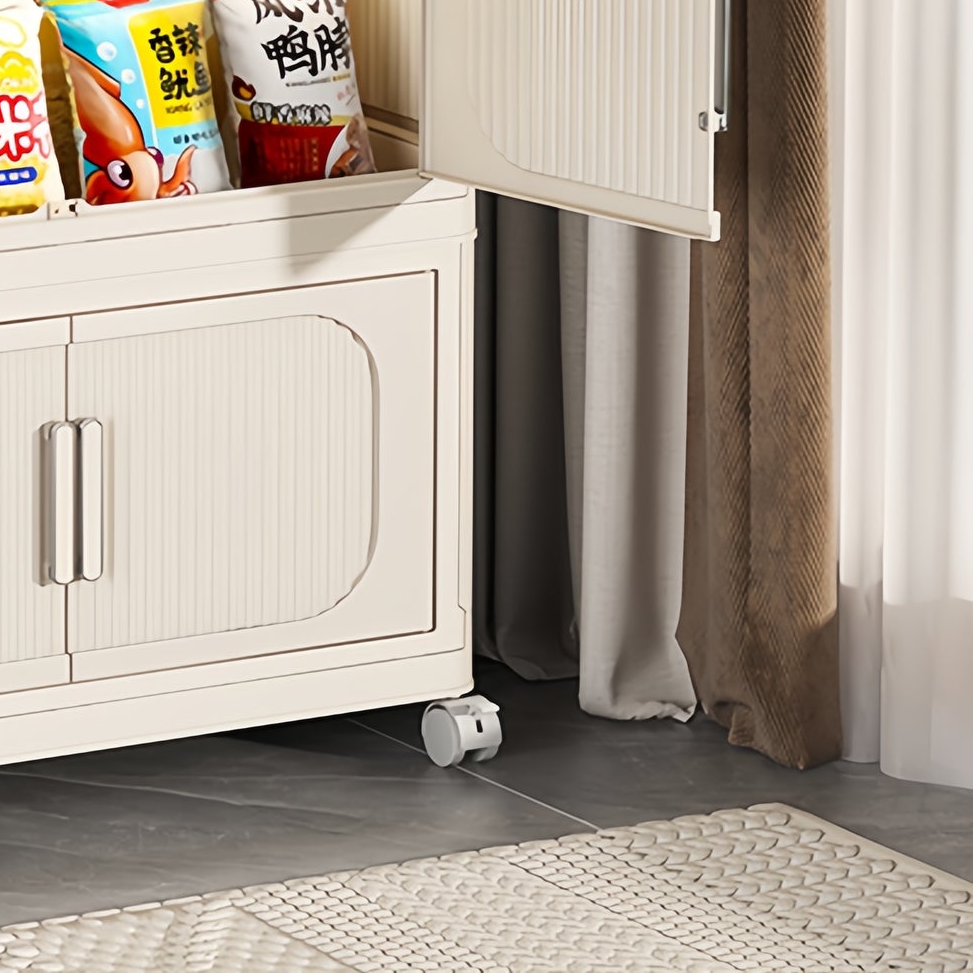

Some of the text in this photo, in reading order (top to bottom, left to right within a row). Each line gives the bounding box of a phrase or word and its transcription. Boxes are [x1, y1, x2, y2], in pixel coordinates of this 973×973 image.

[148, 22, 203, 63] 香辣
[261, 17, 351, 79] 鸭脖
[159, 61, 211, 100] 鱿鱼
